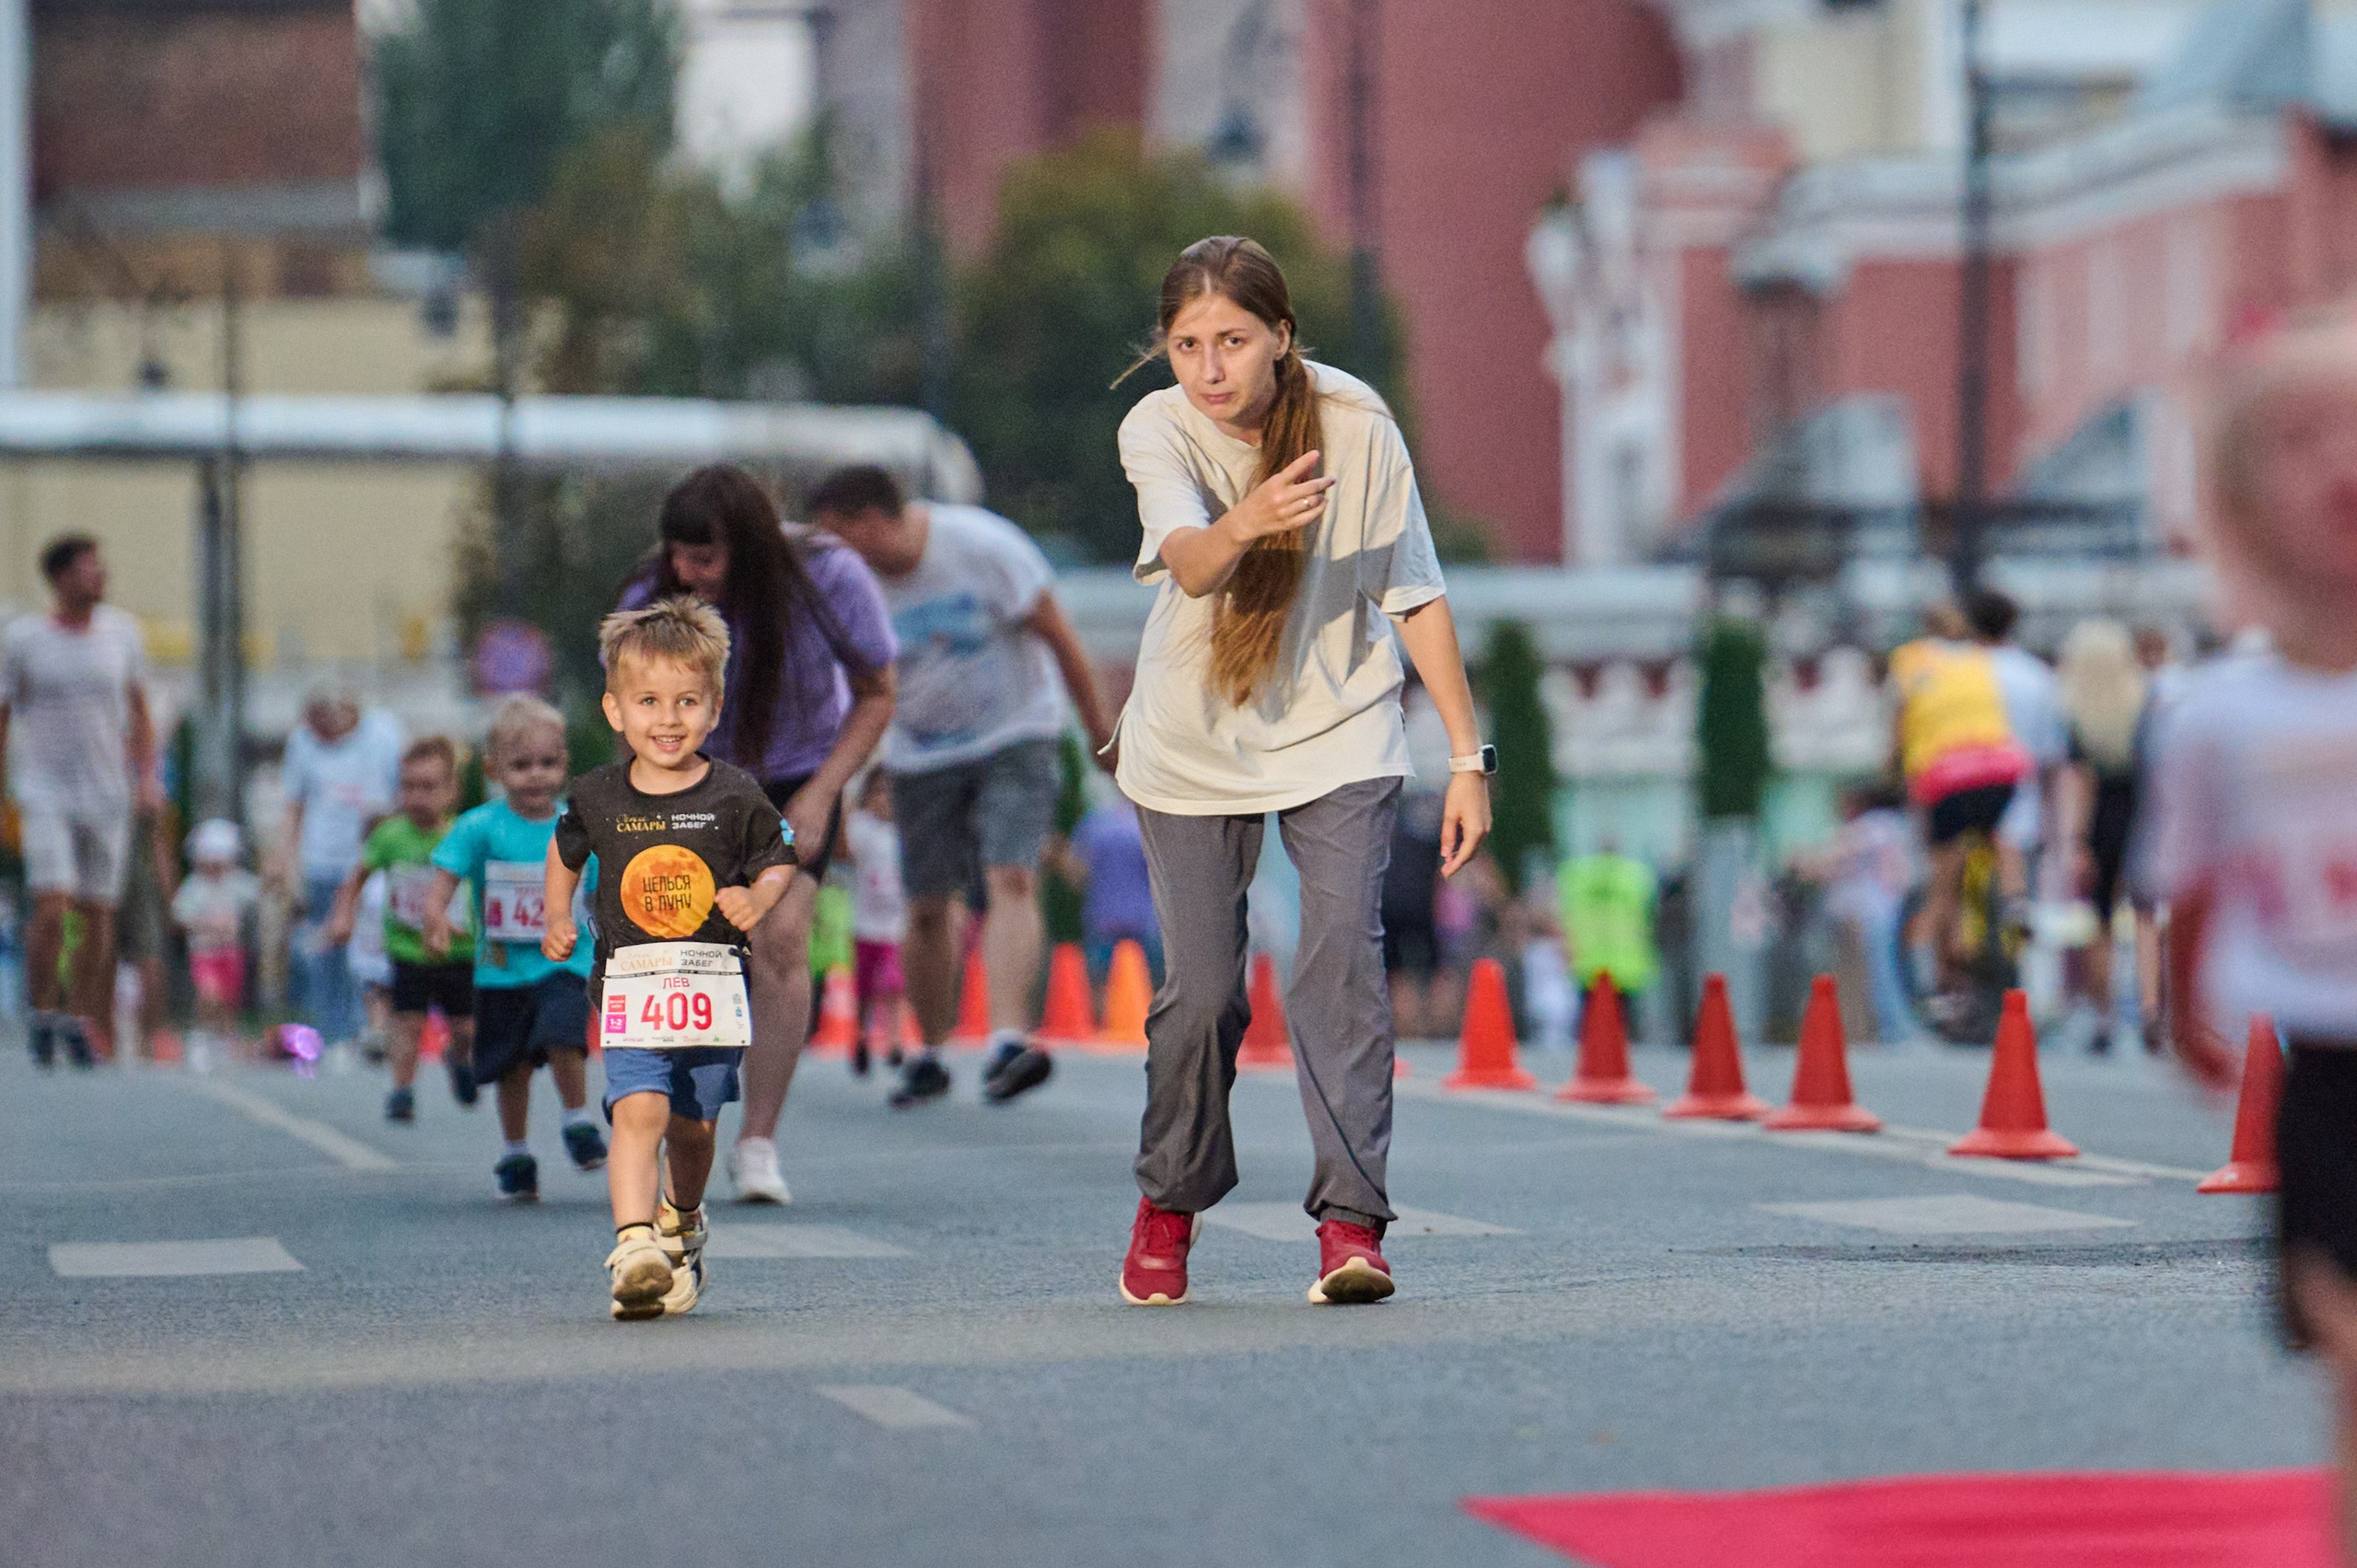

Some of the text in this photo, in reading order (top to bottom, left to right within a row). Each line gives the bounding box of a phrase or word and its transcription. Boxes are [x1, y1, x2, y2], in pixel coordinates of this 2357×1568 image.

[671, 813, 715, 821] НОЧНОЙ
[616, 821, 667, 832] САМАРЫ
[643, 875, 691, 894] ЦЕЛЬСЯ
[644, 893, 691, 912] В ЛУНУ
[680, 949, 723, 958] НОЧНОЙ
[620, 958, 672, 971] САМАРЫ
[680, 958, 714, 968] ЗАБЕГ
[662, 978, 691, 989] ЛЕВ
[641, 992, 713, 1030] 409
